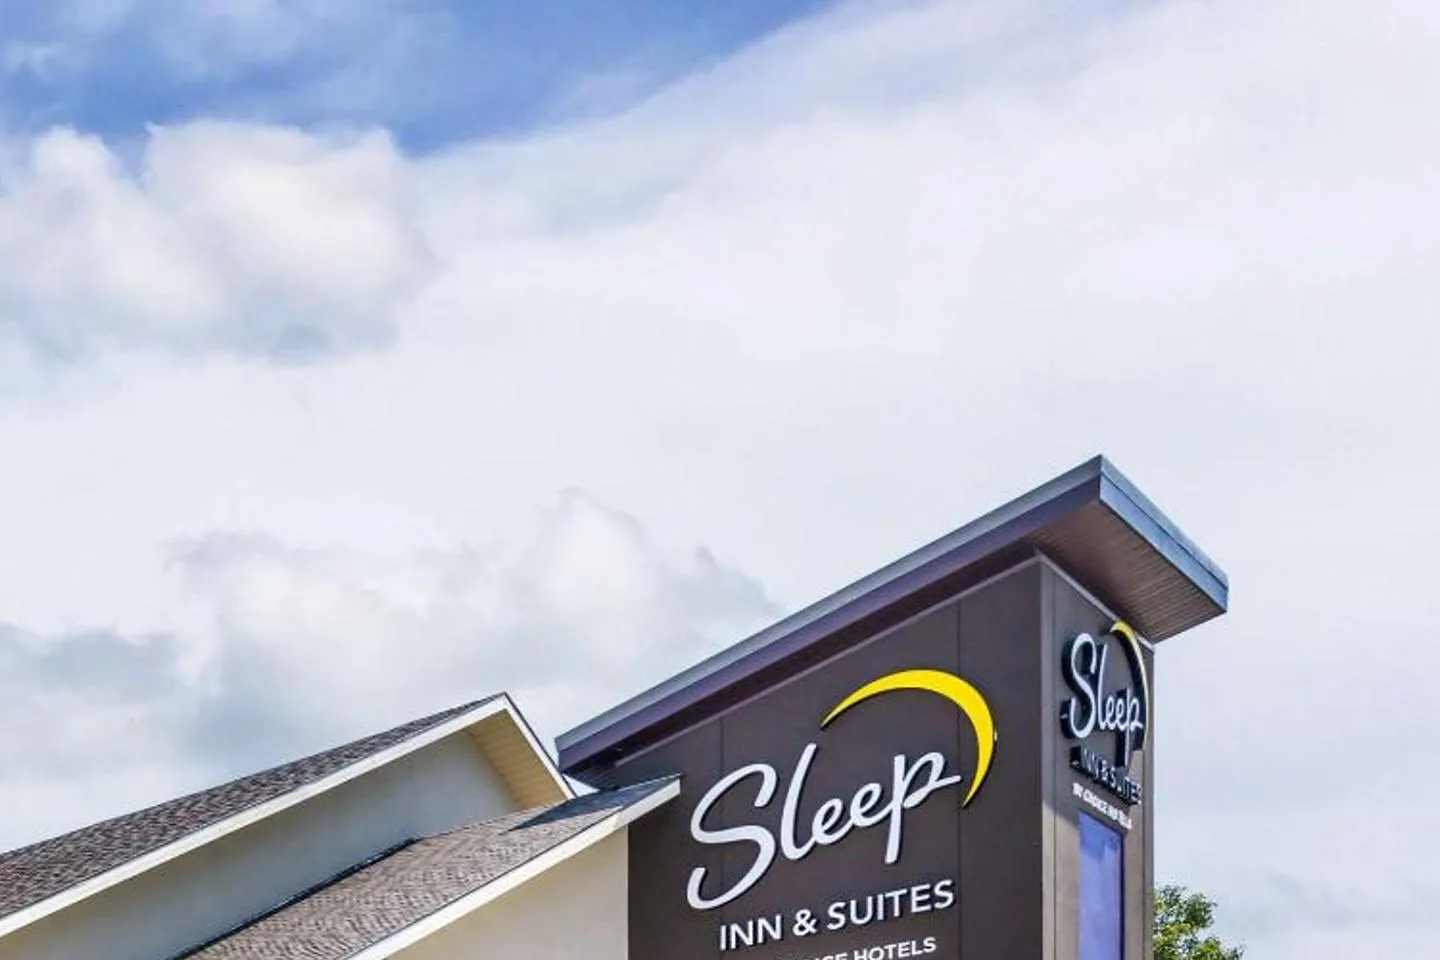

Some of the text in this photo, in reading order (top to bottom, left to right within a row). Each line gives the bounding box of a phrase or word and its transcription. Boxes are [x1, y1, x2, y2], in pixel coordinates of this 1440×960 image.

[1070, 632, 1143, 767] Sleep
[686, 742, 961, 910] Sleep
[719, 878, 956, 951] INN & SUITES
